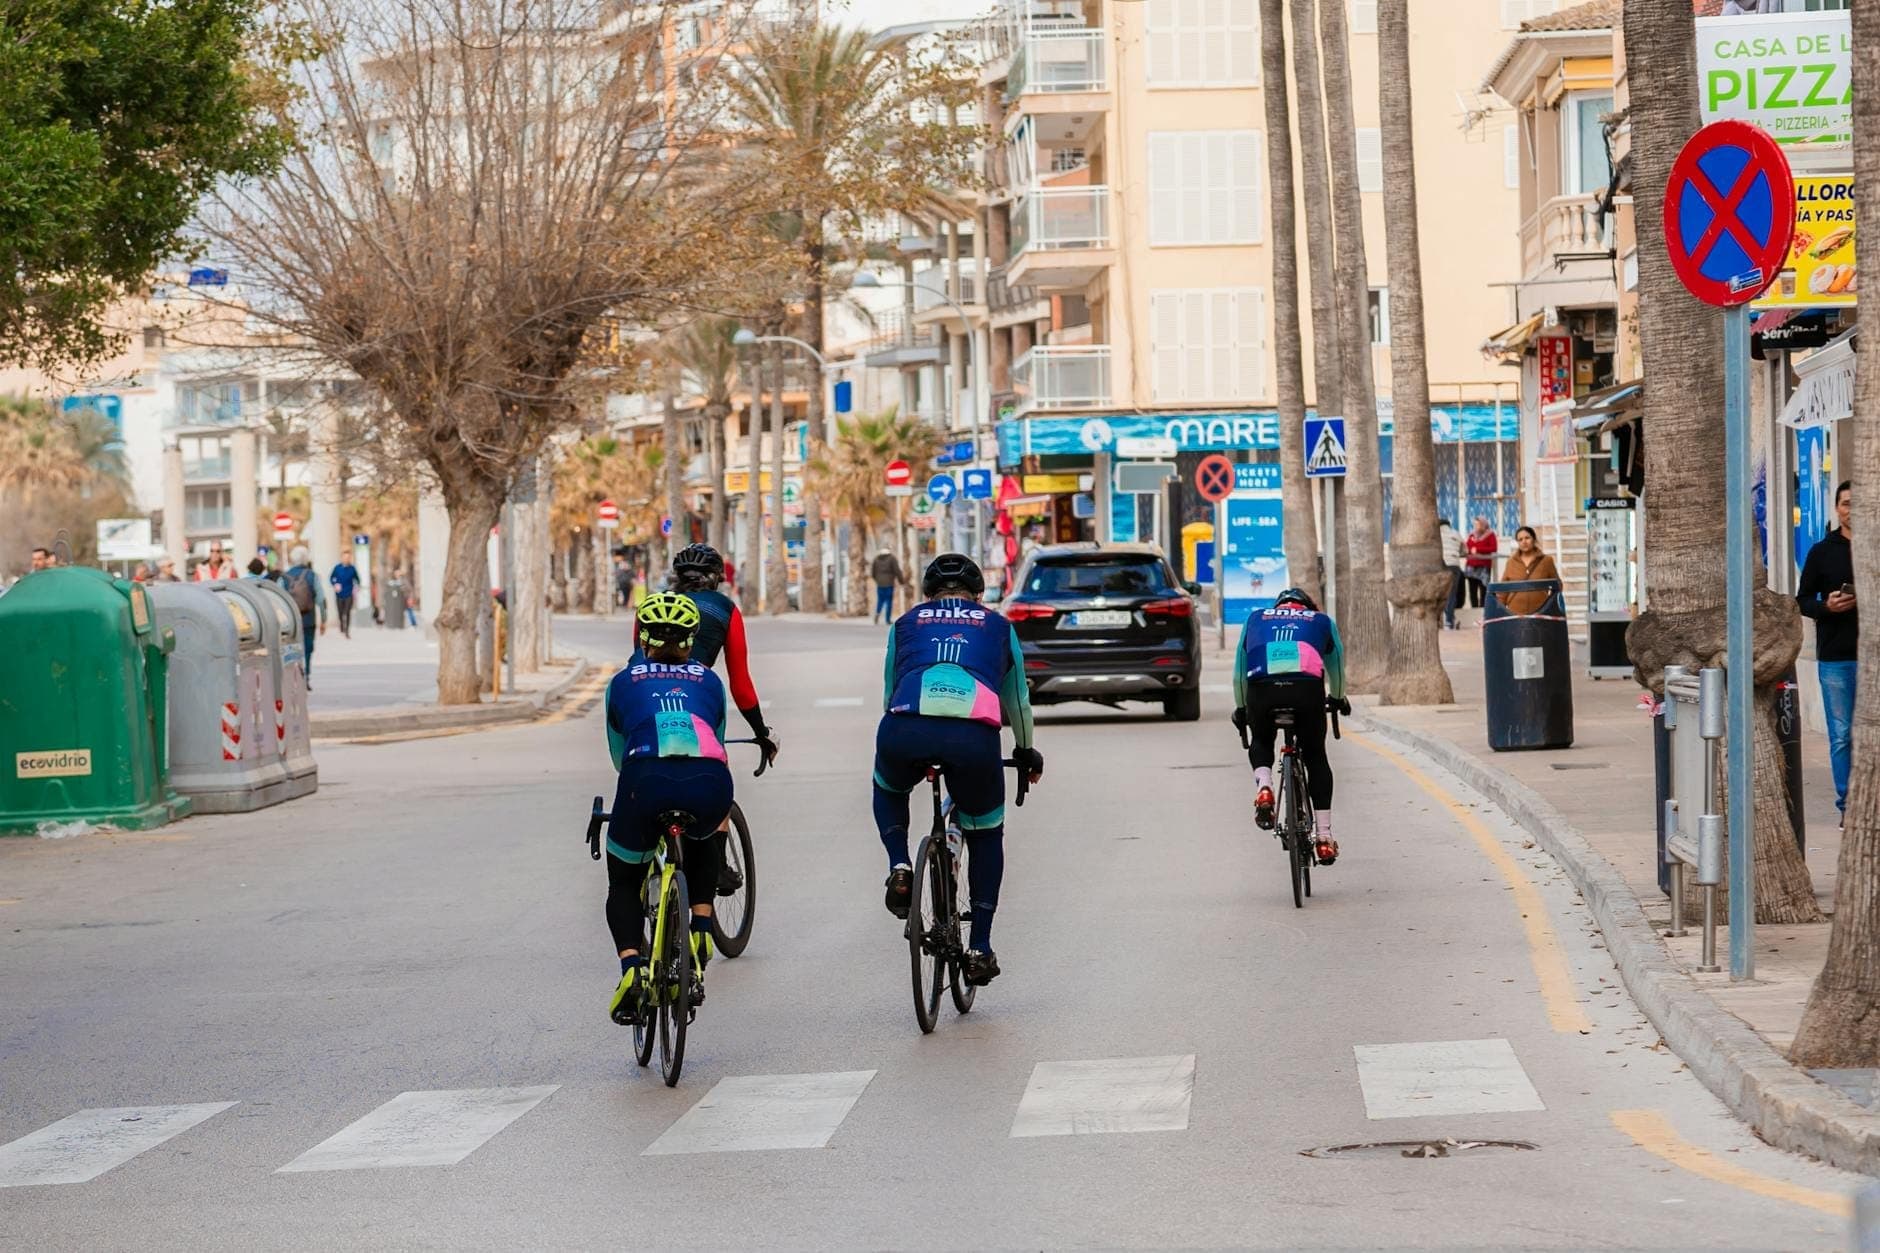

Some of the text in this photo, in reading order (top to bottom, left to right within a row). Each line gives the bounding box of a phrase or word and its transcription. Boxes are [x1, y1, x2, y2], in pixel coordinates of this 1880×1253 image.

[1714, 37, 1787, 59] CASA
[1796, 34, 1831, 55] DE
[1775, 116, 1830, 131] PIZZERIA
[1815, 210, 1824, 222] Y
[1596, 499, 1628, 508] CASIO
[918, 606, 986, 620] anke
[630, 662, 705, 676] anke
[20, 753, 88, 770] ecovidrio
